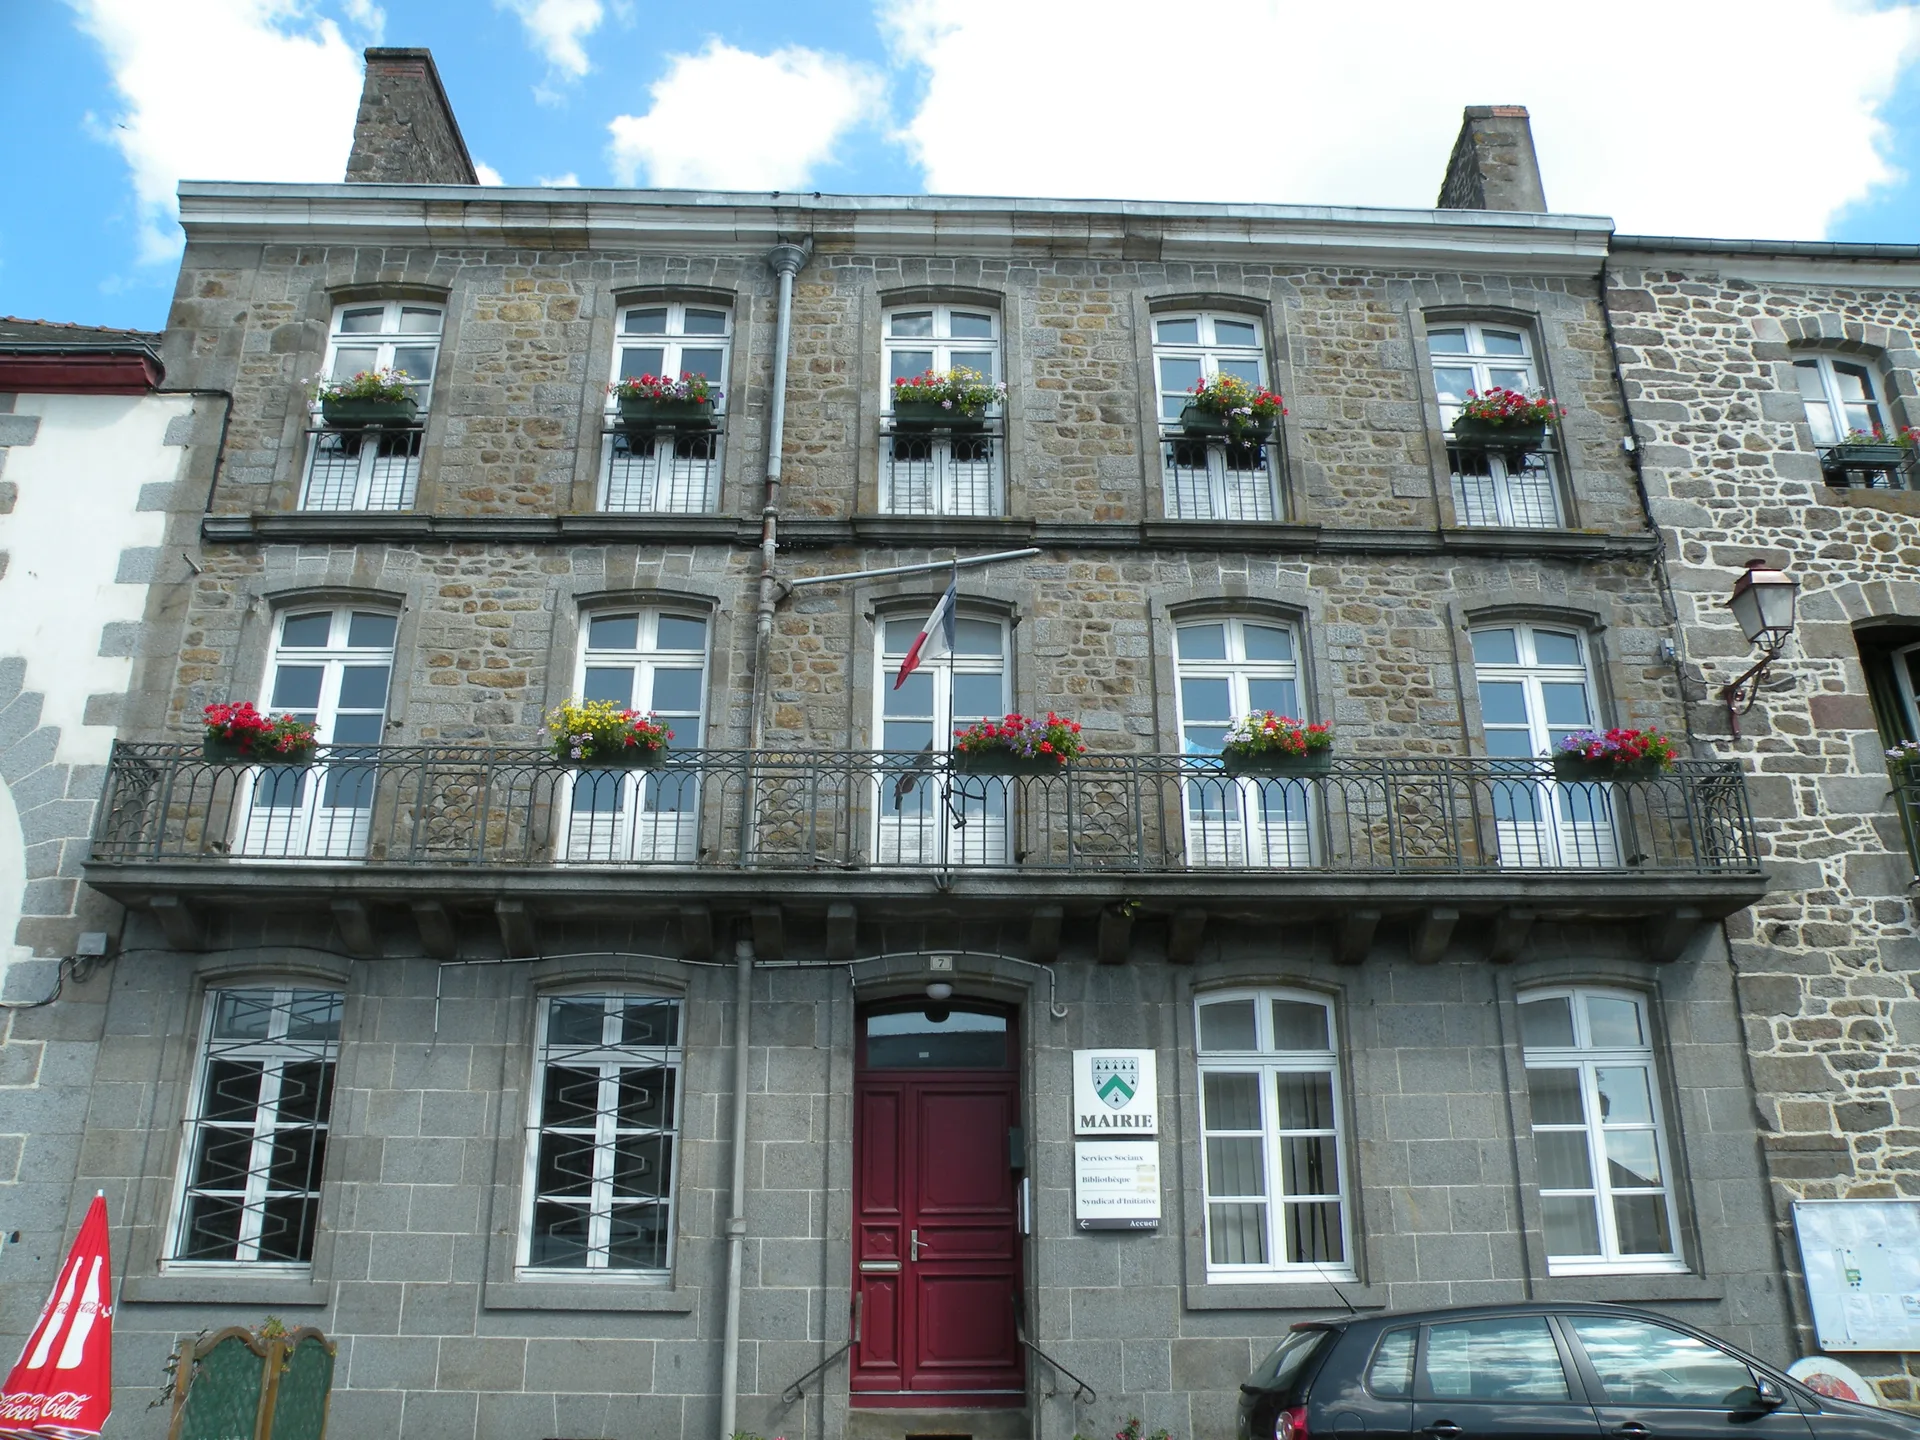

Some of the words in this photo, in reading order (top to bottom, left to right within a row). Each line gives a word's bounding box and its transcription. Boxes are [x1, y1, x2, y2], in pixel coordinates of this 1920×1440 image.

[938, 958, 945, 968] 7
[1080, 1114, 1153, 1128] MAIRIE
[1114, 1154, 1144, 1162] Sociaux
[1082, 1176, 1131, 1184] Bibliothèque
[1082, 1198, 1115, 1207] Syndicat
[1116, 1197, 1157, 1205] d'Initiative
[1130, 1219, 1159, 1227] Accueil
